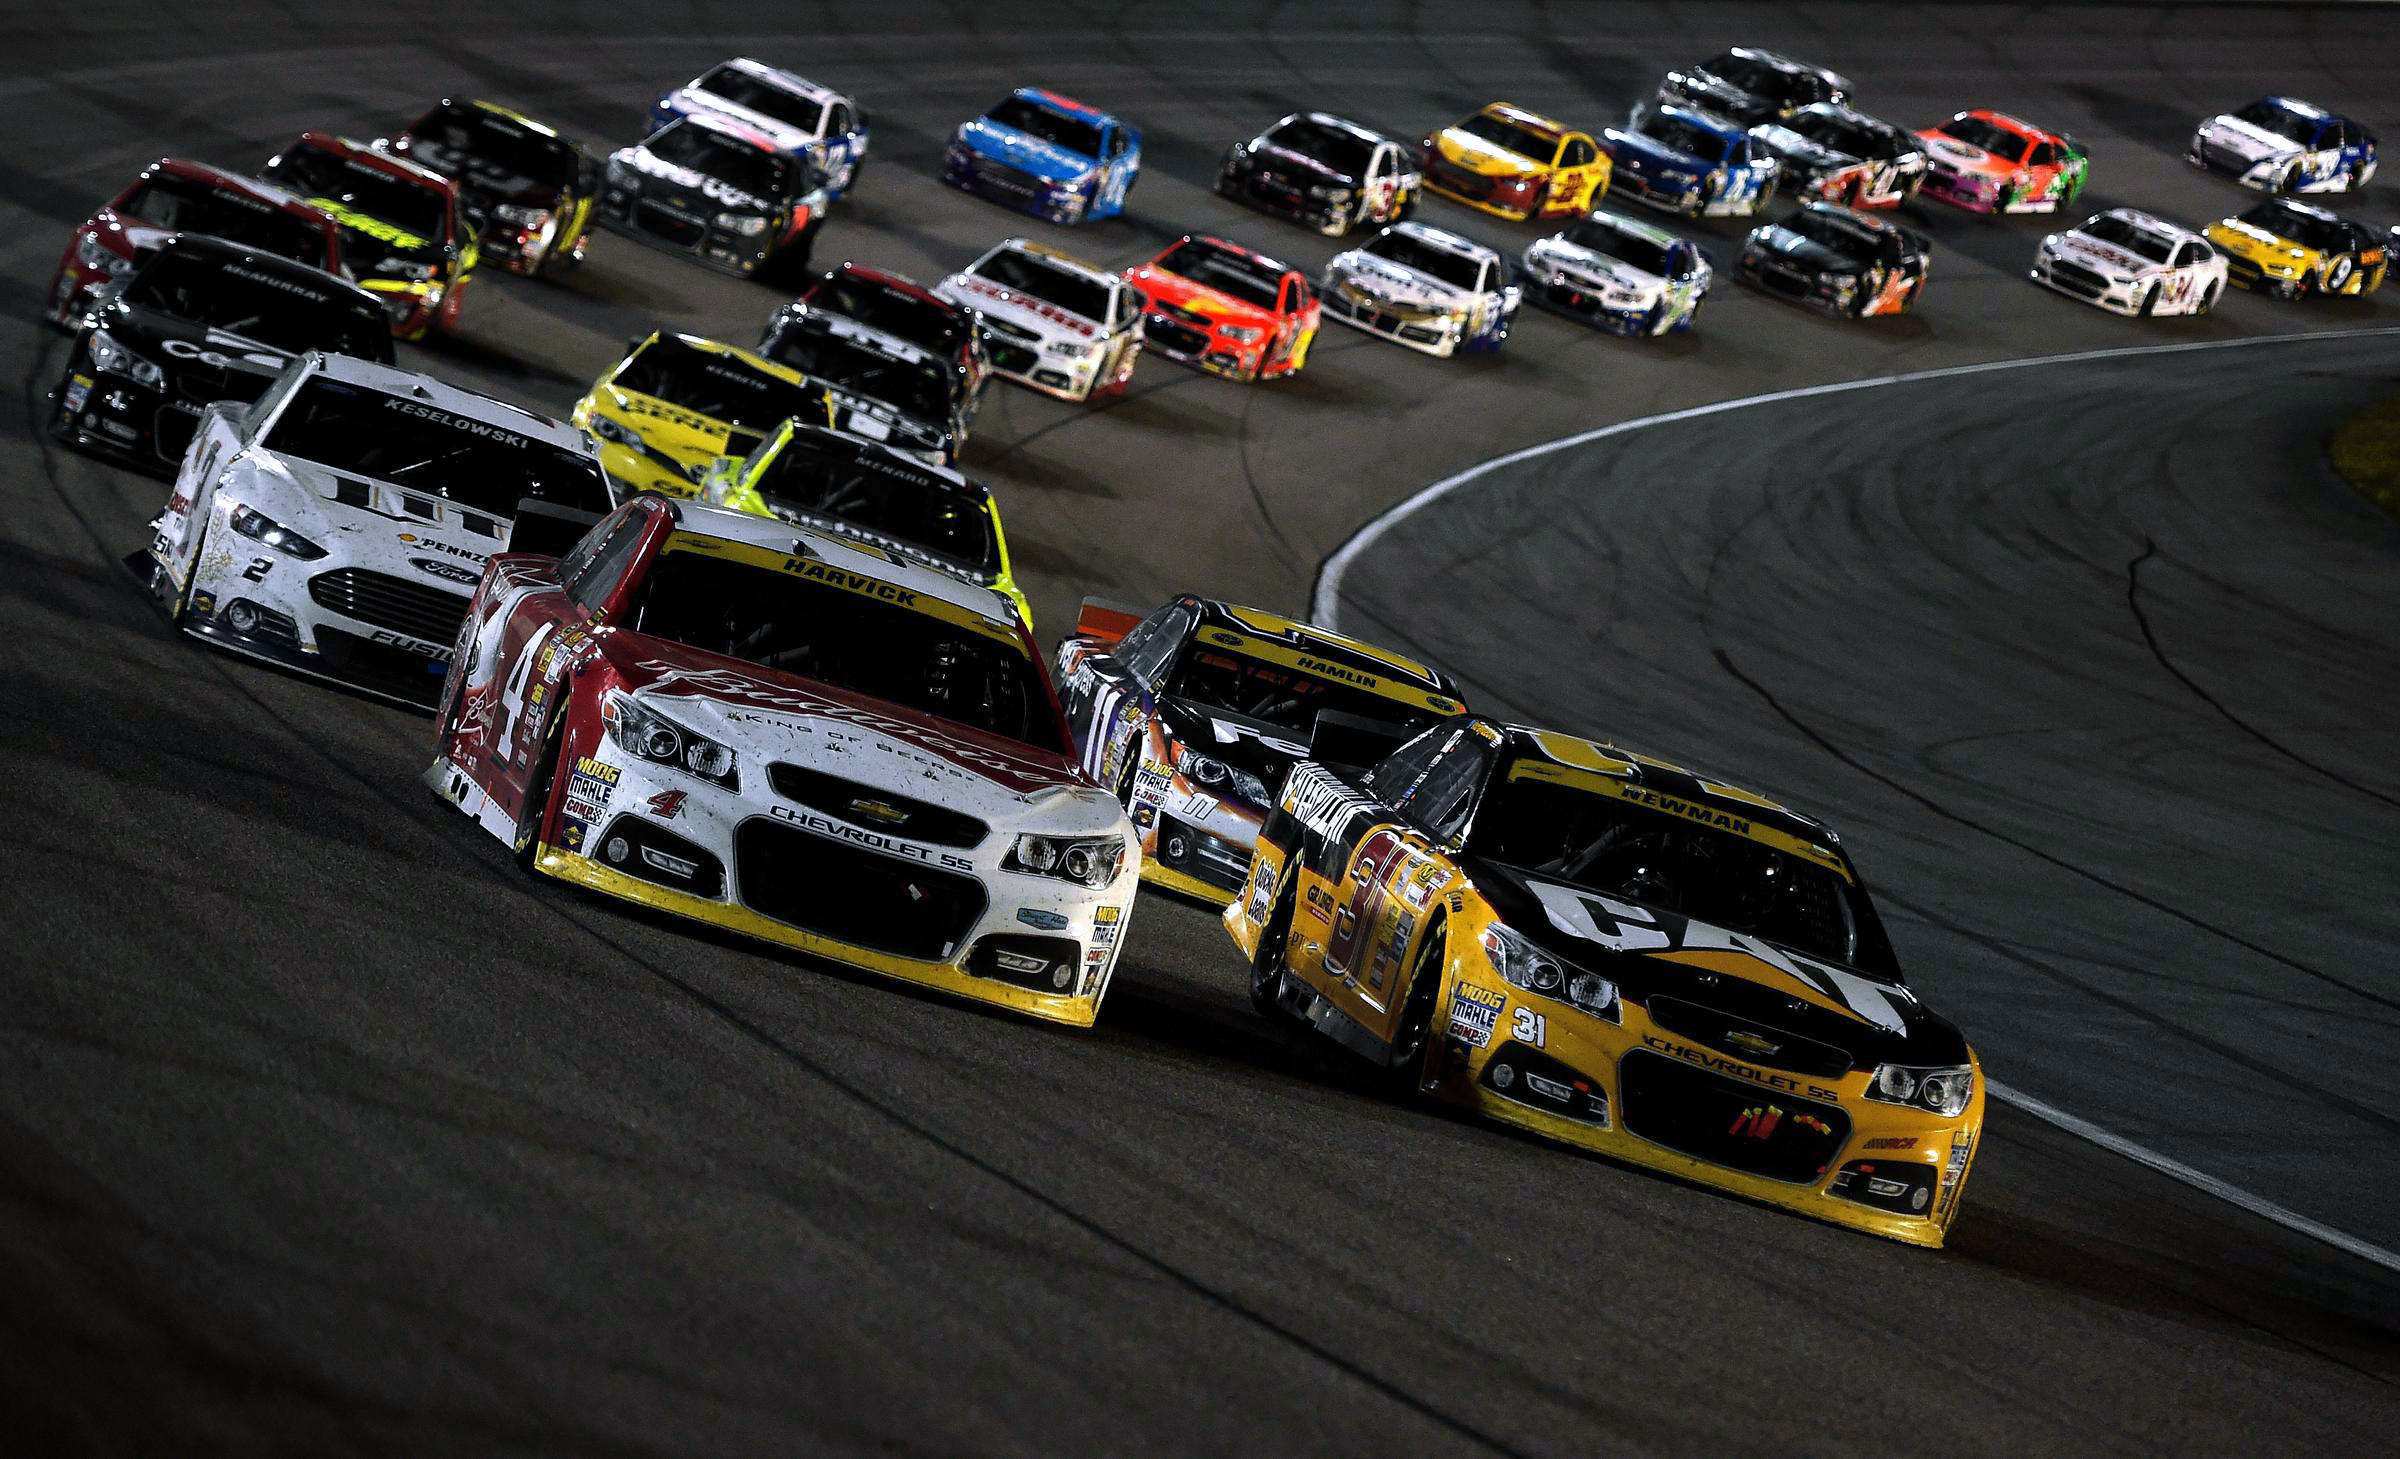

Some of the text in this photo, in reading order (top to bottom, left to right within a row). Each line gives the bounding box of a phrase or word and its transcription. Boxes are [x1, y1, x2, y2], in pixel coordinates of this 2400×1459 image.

[384, 399, 529, 449] KESELOWSKI
[242, 556, 274, 583] 2
[425, 559, 475, 584] Ford
[783, 558, 917, 606] HARVICK
[371, 629, 454, 662] FUSI
[1297, 657, 1377, 689] HAMLIN
[496, 620, 554, 762] 4
[690, 668, 1052, 783] Budweise
[746, 714, 813, 734] KING
[827, 730, 863, 744] OF
[576, 755, 621, 785] MOOG
[1135, 771, 1172, 792] MAHLE
[569, 776, 613, 803] MAHLE
[647, 789, 688, 820] 4
[1181, 792, 1220, 821] 11
[1621, 787, 1751, 834] NEWMAN
[769, 805, 974, 872] CHEVROLET SS
[1525, 880, 1917, 1040] CAT
[1459, 981, 1505, 1009] MOOG
[1452, 1001, 1497, 1028] MAHLE
[1511, 1005, 1546, 1049] 31
[1645, 1035, 1839, 1102] CHEVROLET SS
